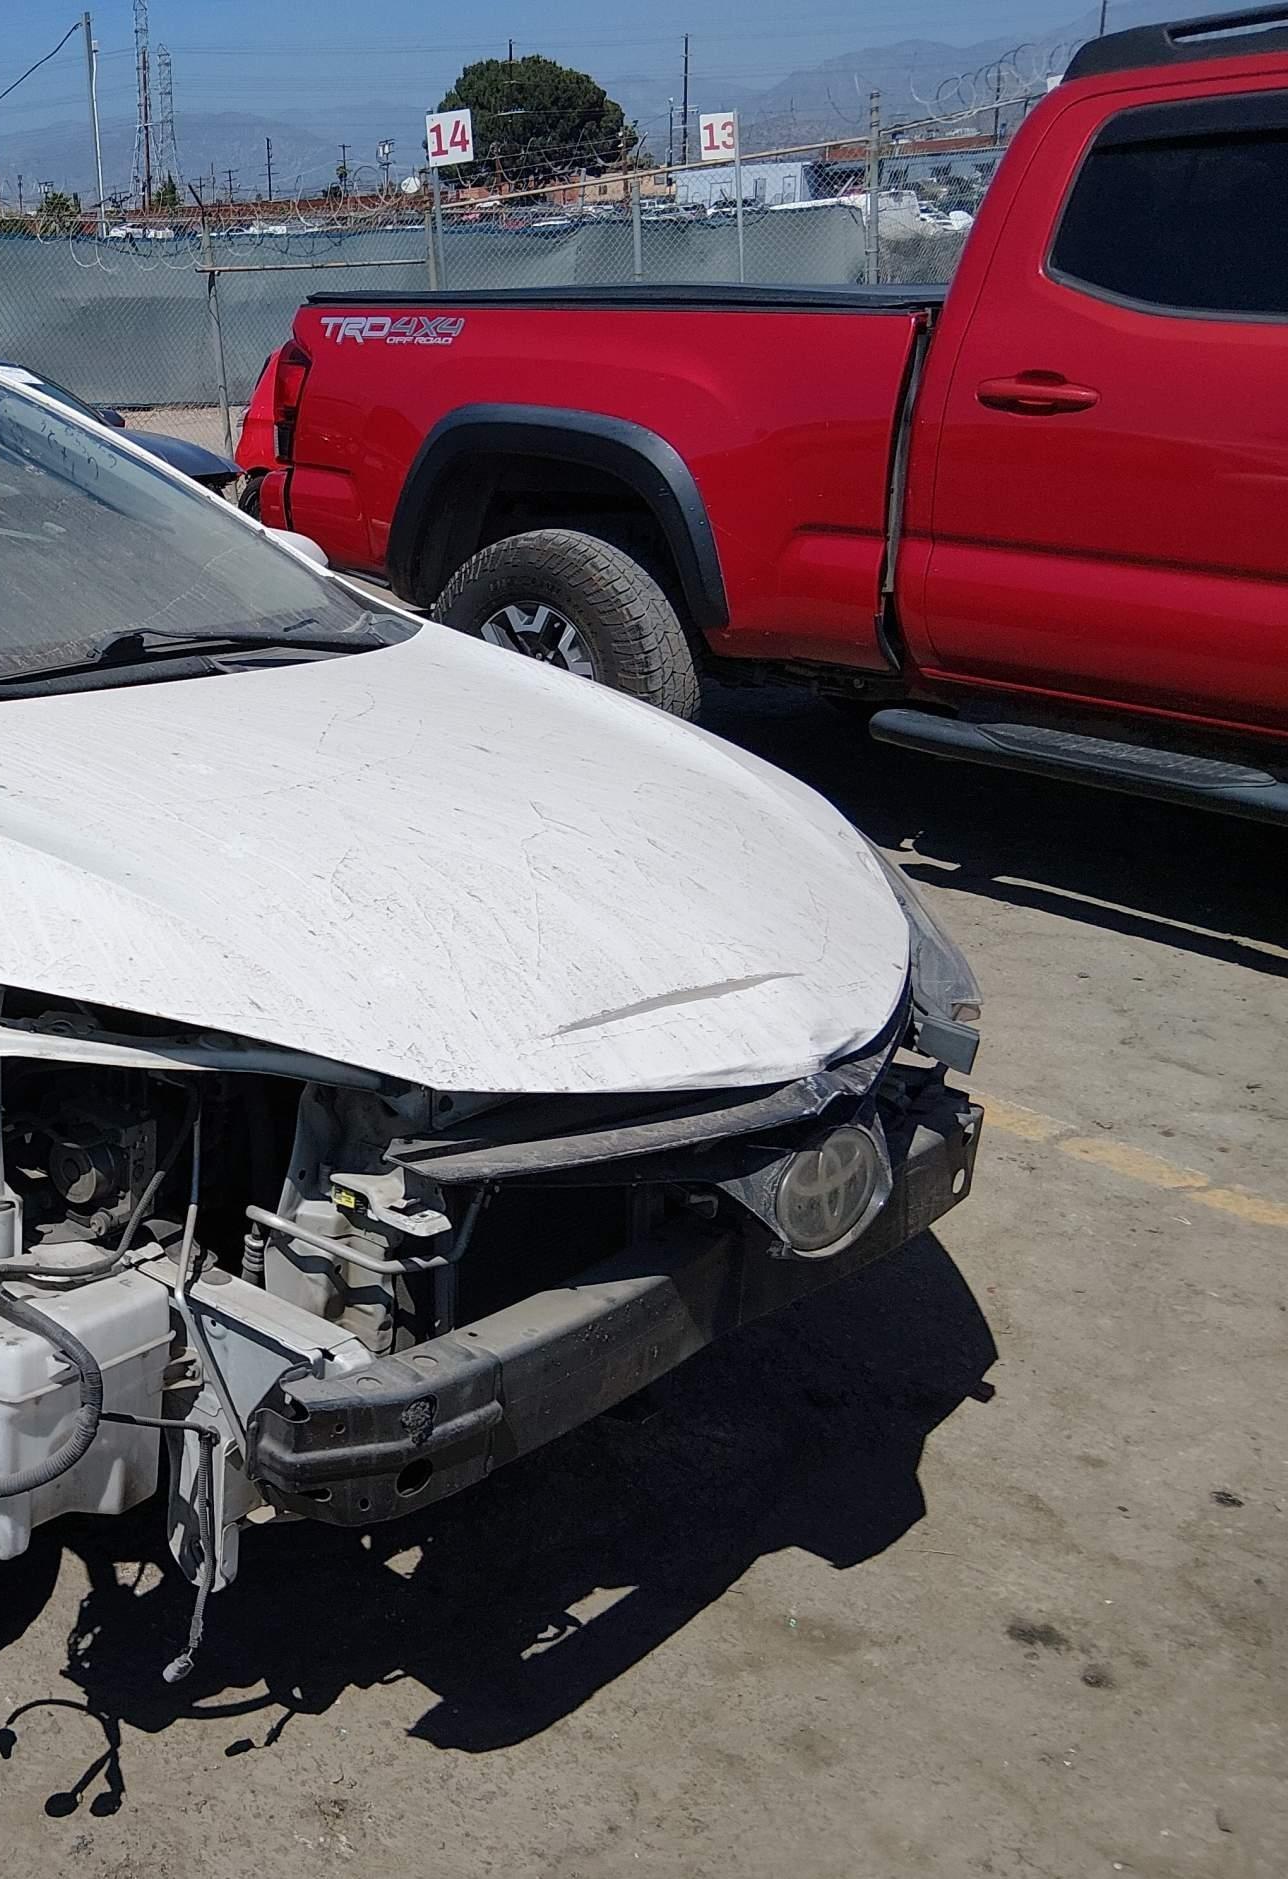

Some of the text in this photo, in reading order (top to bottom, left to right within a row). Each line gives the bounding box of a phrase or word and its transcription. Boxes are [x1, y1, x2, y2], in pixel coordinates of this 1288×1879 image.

[429, 120, 470, 157] 14
[703, 121, 736, 150] 13
[320, 316, 392, 344] TRD
[386, 336, 453, 344] OFF ROAD
